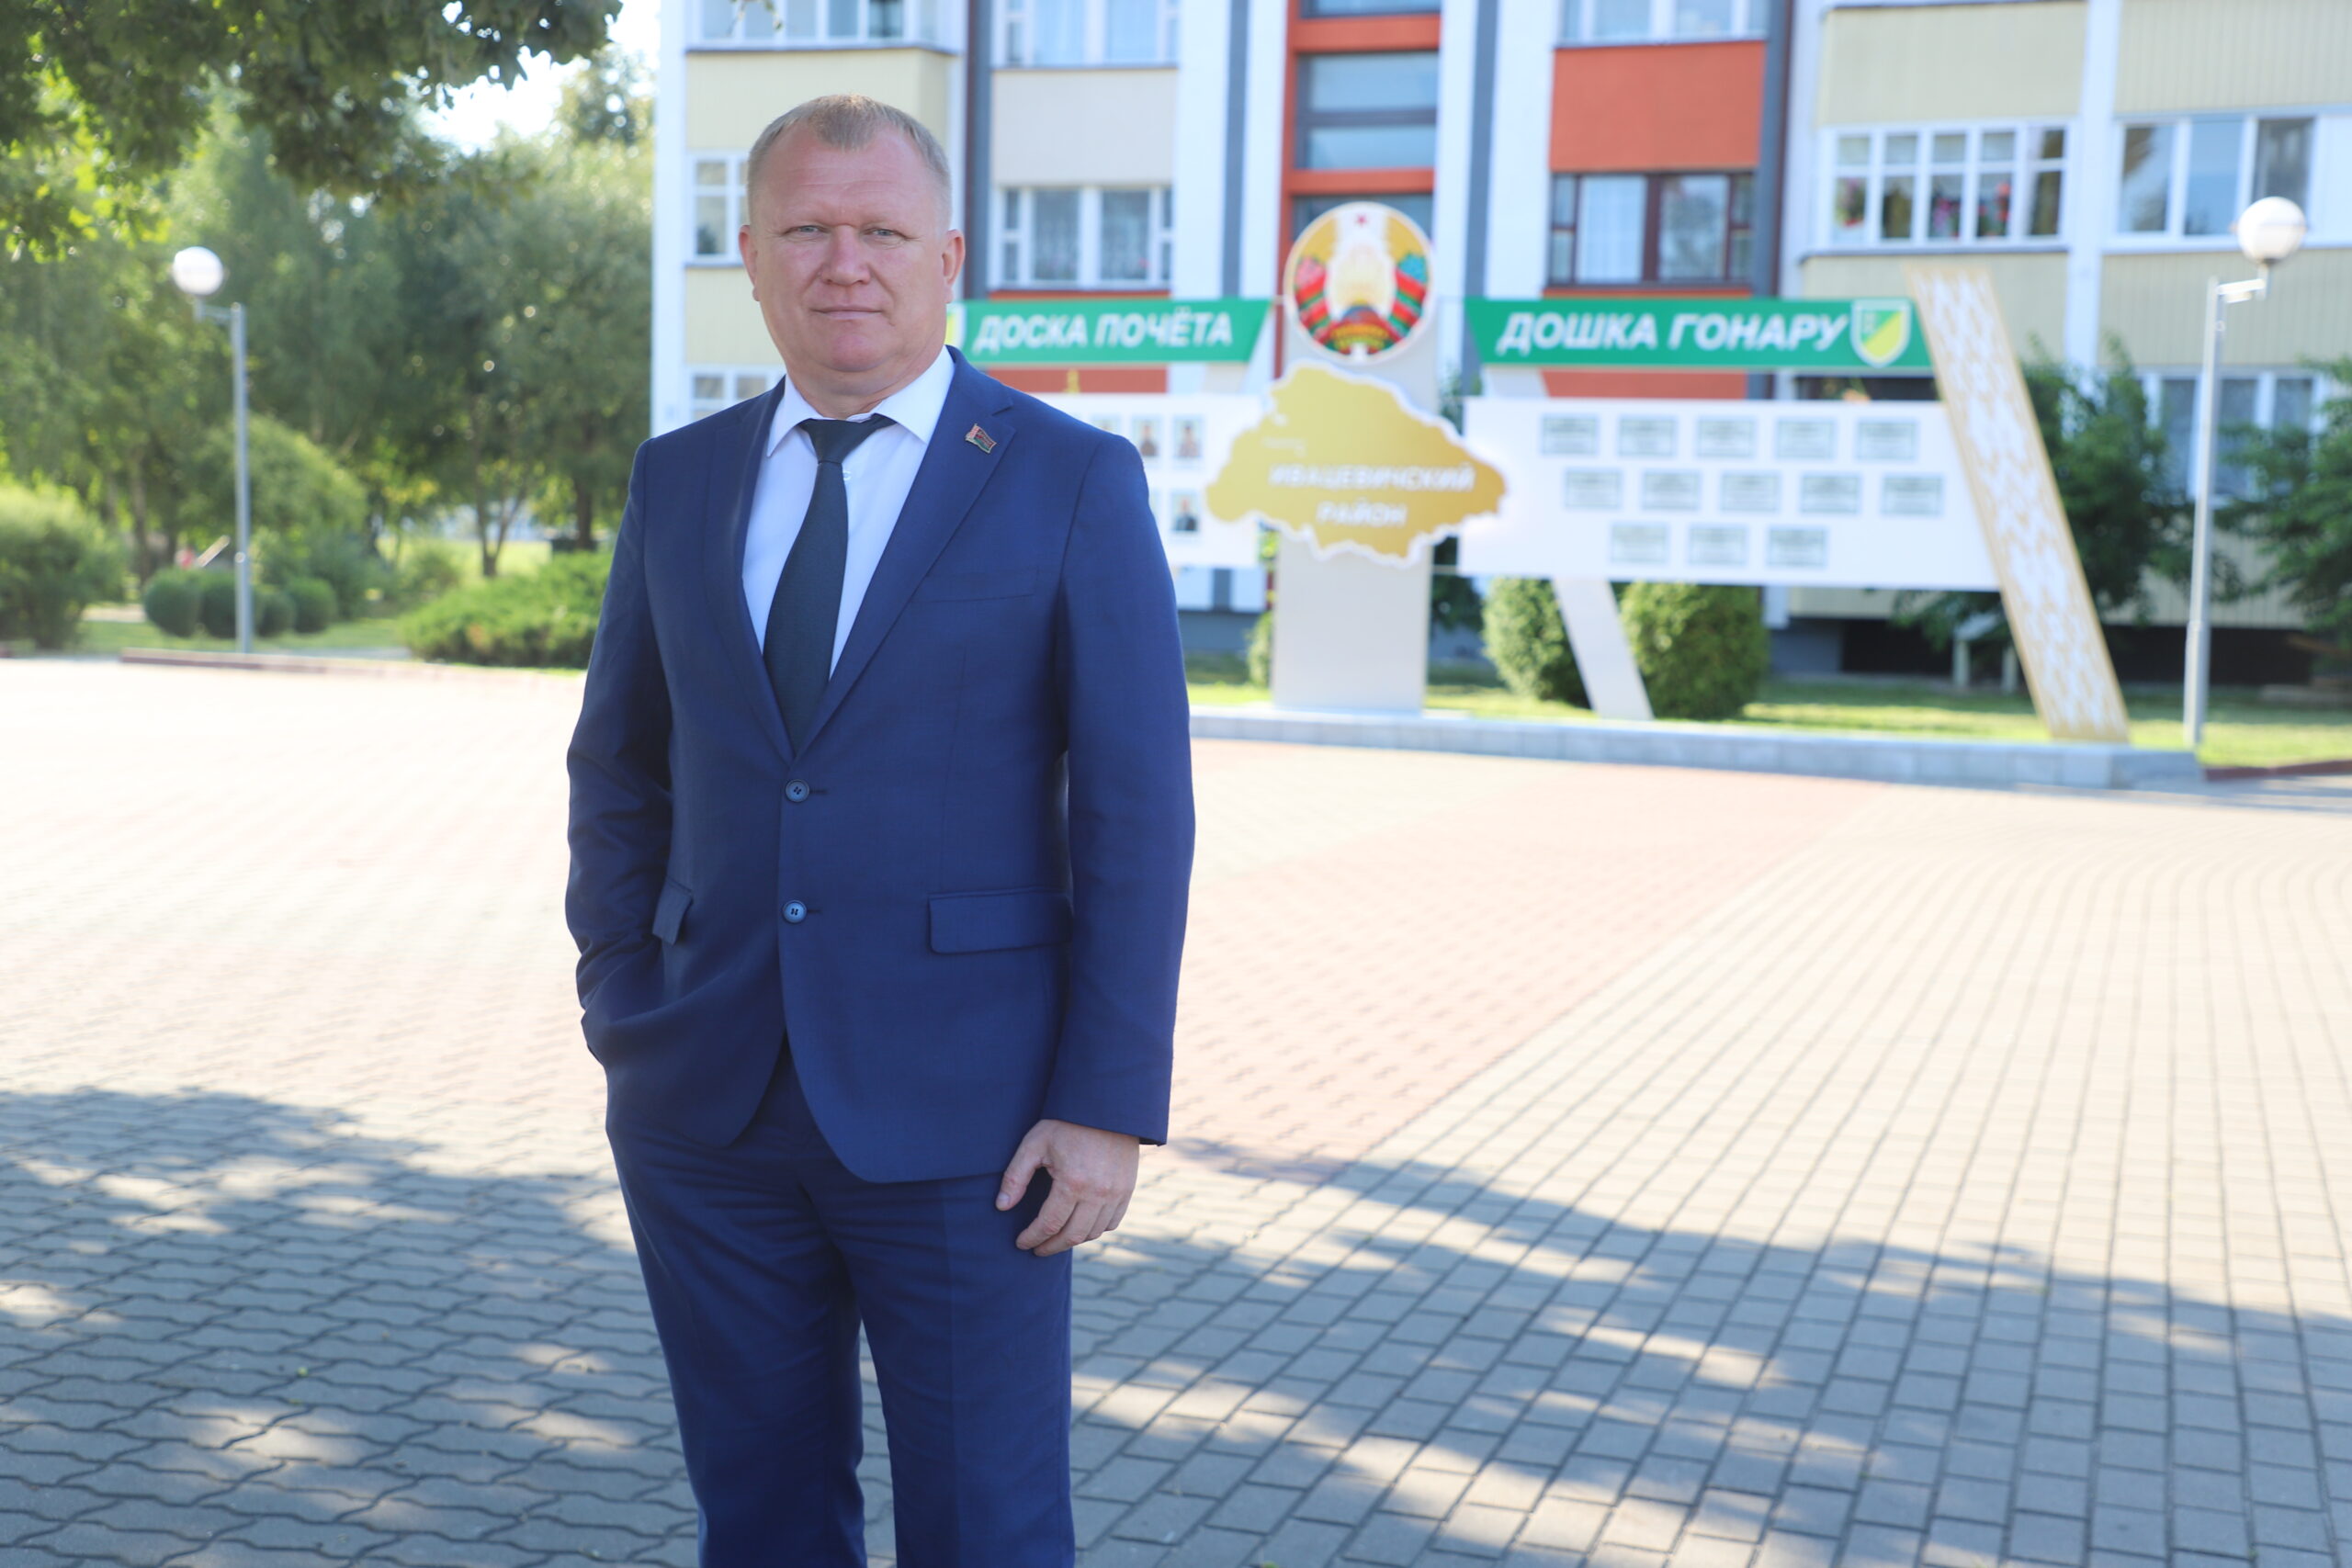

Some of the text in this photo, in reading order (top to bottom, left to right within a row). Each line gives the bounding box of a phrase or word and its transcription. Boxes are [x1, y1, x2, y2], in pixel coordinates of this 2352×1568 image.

[972, 306, 1233, 355] ДОСКА ПОЧЁТА
[1496, 312, 1849, 355] ДОШКА ГОНАРУ
[1316, 497, 1408, 529] РАЙОН
